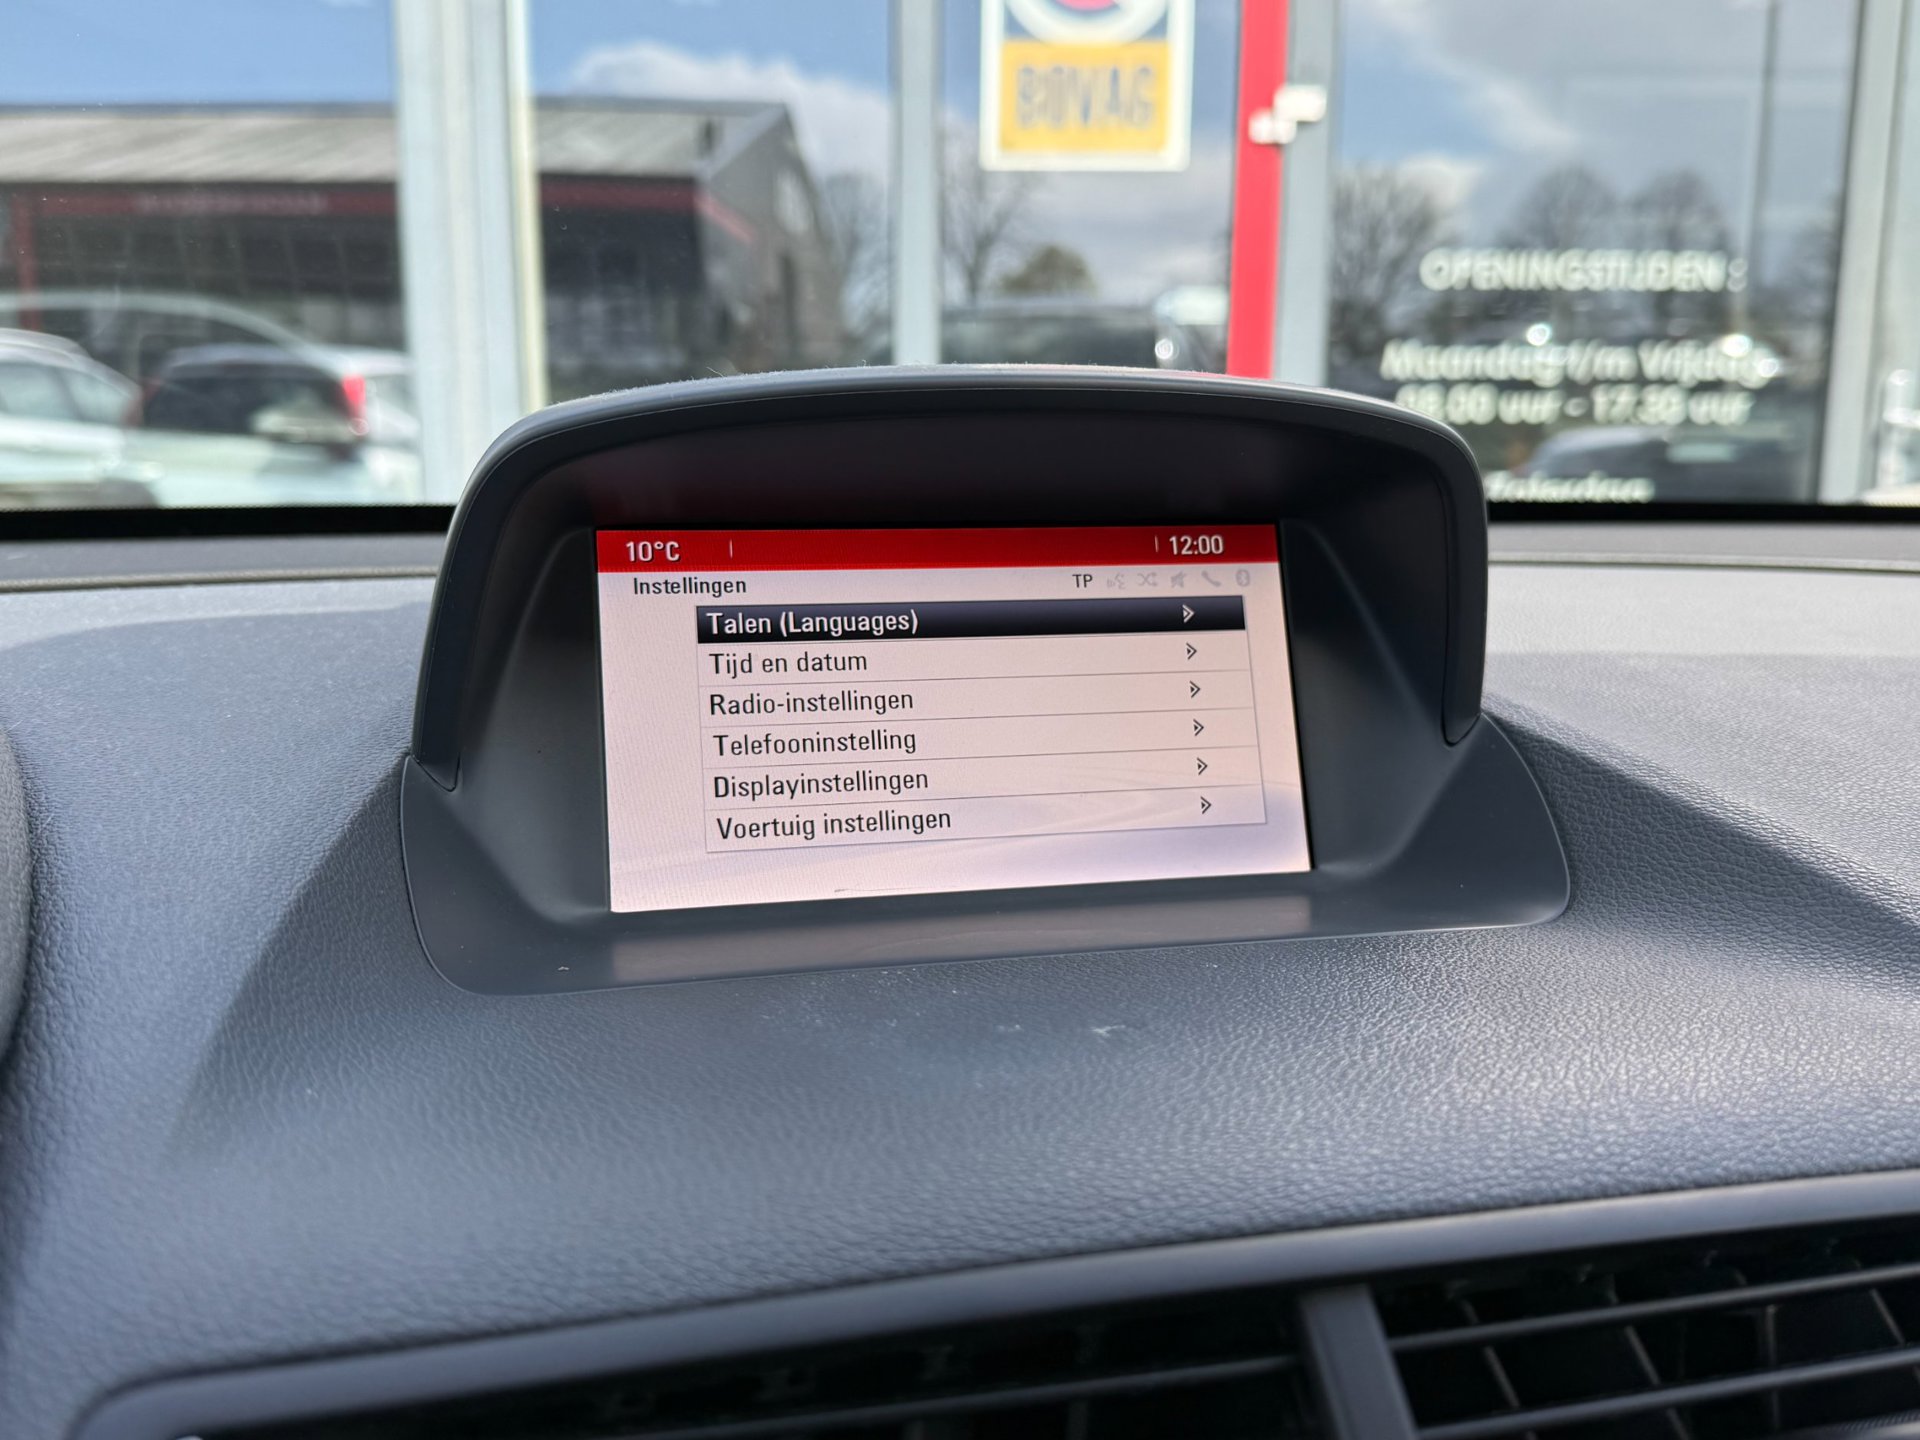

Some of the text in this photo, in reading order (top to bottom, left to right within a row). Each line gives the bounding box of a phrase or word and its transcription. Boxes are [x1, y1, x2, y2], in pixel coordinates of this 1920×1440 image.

[1016, 65, 1154, 129] BOVAG
[1381, 340, 1567, 388] Maandag
[625, 540, 681, 563] 10°C
[1169, 534, 1225, 556] 12:00
[633, 576, 747, 598] Instellingen
[1072, 573, 1093, 589] TP
[706, 609, 919, 637] Talen (Languages)
[709, 651, 868, 679] Tijd en datum
[710, 690, 914, 716] Radio-instellingen
[713, 729, 917, 757] Telefooninstelling
[714, 770, 929, 801] Displayinstellingen
[717, 810, 952, 841] Voertuig instellingen
